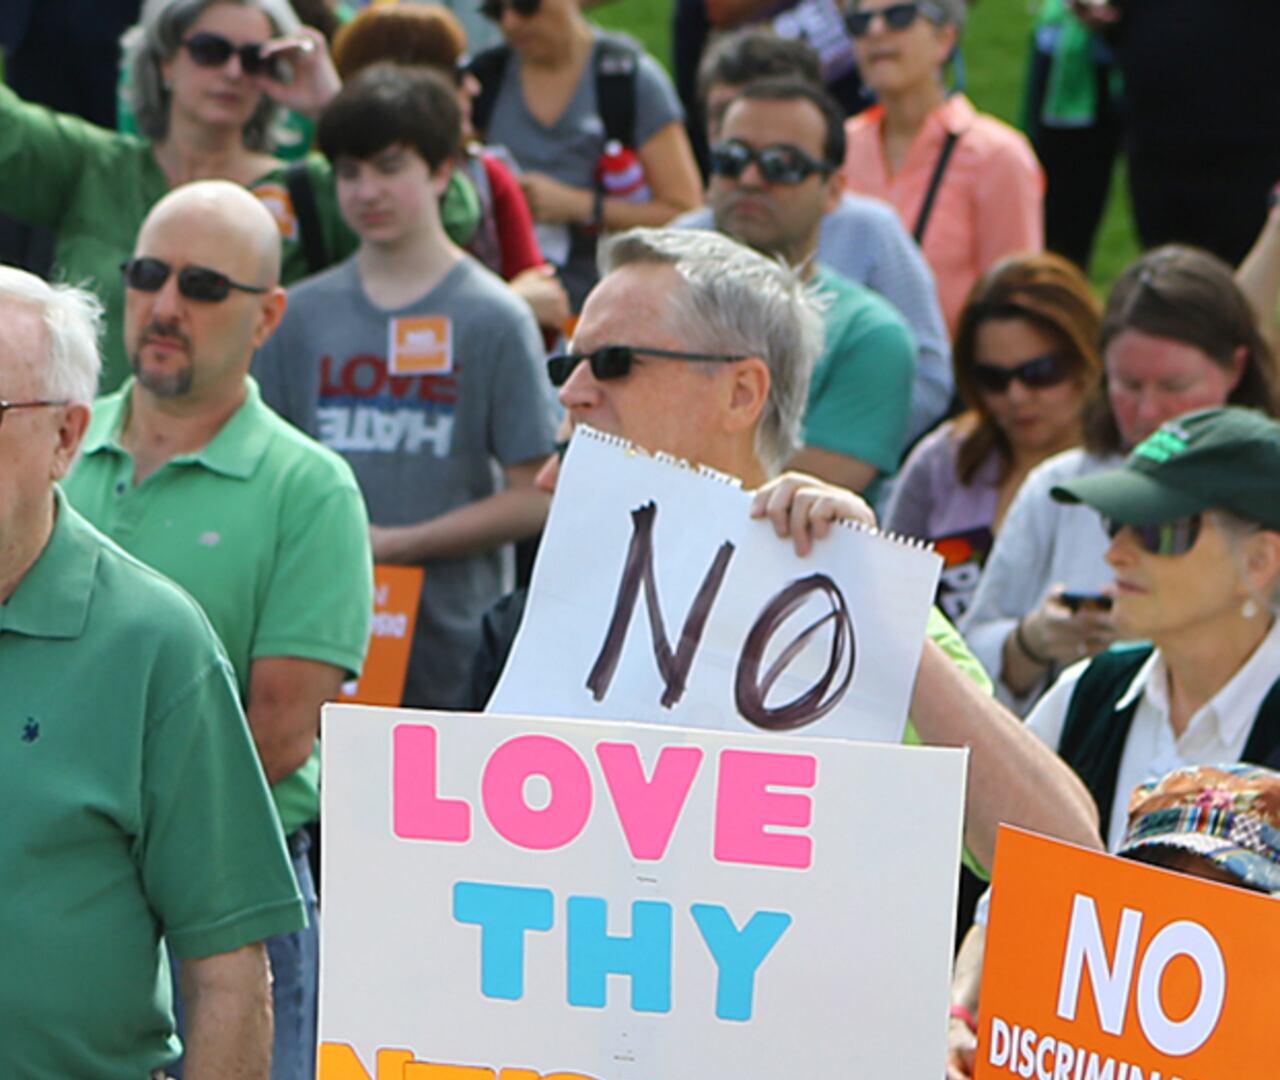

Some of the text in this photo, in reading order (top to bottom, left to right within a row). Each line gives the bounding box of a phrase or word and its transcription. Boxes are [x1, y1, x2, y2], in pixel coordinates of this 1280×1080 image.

[584, 498, 859, 732] NO
[392, 722, 818, 871] LOVE
[452, 880, 794, 1023] THY
[1056, 892, 1228, 1058] NO
